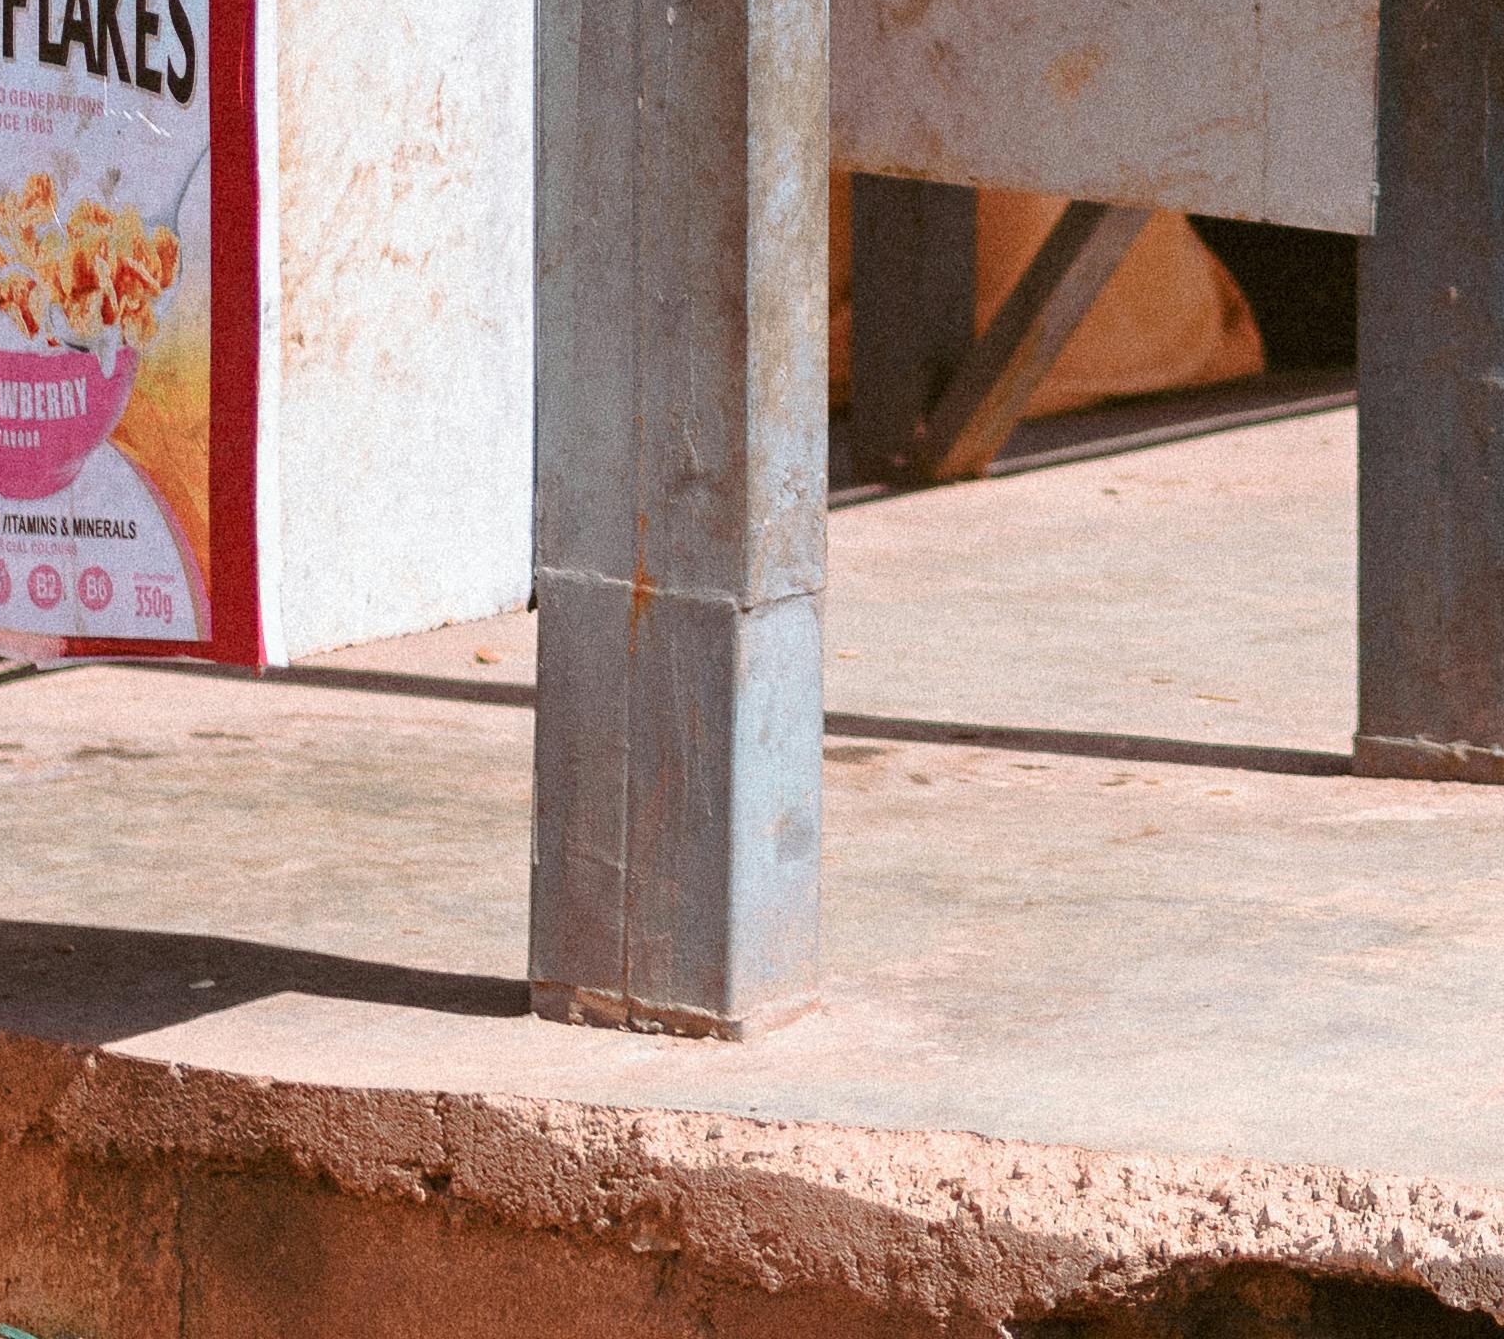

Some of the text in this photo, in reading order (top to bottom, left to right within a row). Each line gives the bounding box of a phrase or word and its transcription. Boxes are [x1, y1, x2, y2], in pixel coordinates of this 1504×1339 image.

[9, 89, 105, 118] GENERATIONS
[25, 117, 54, 135] 1963
[60, 516, 69, 535] &
[72, 517, 138, 540] MINERALS
[35, 572, 57, 599] B2
[86, 576, 107, 601] B6
[134, 585, 173, 625] 350g
